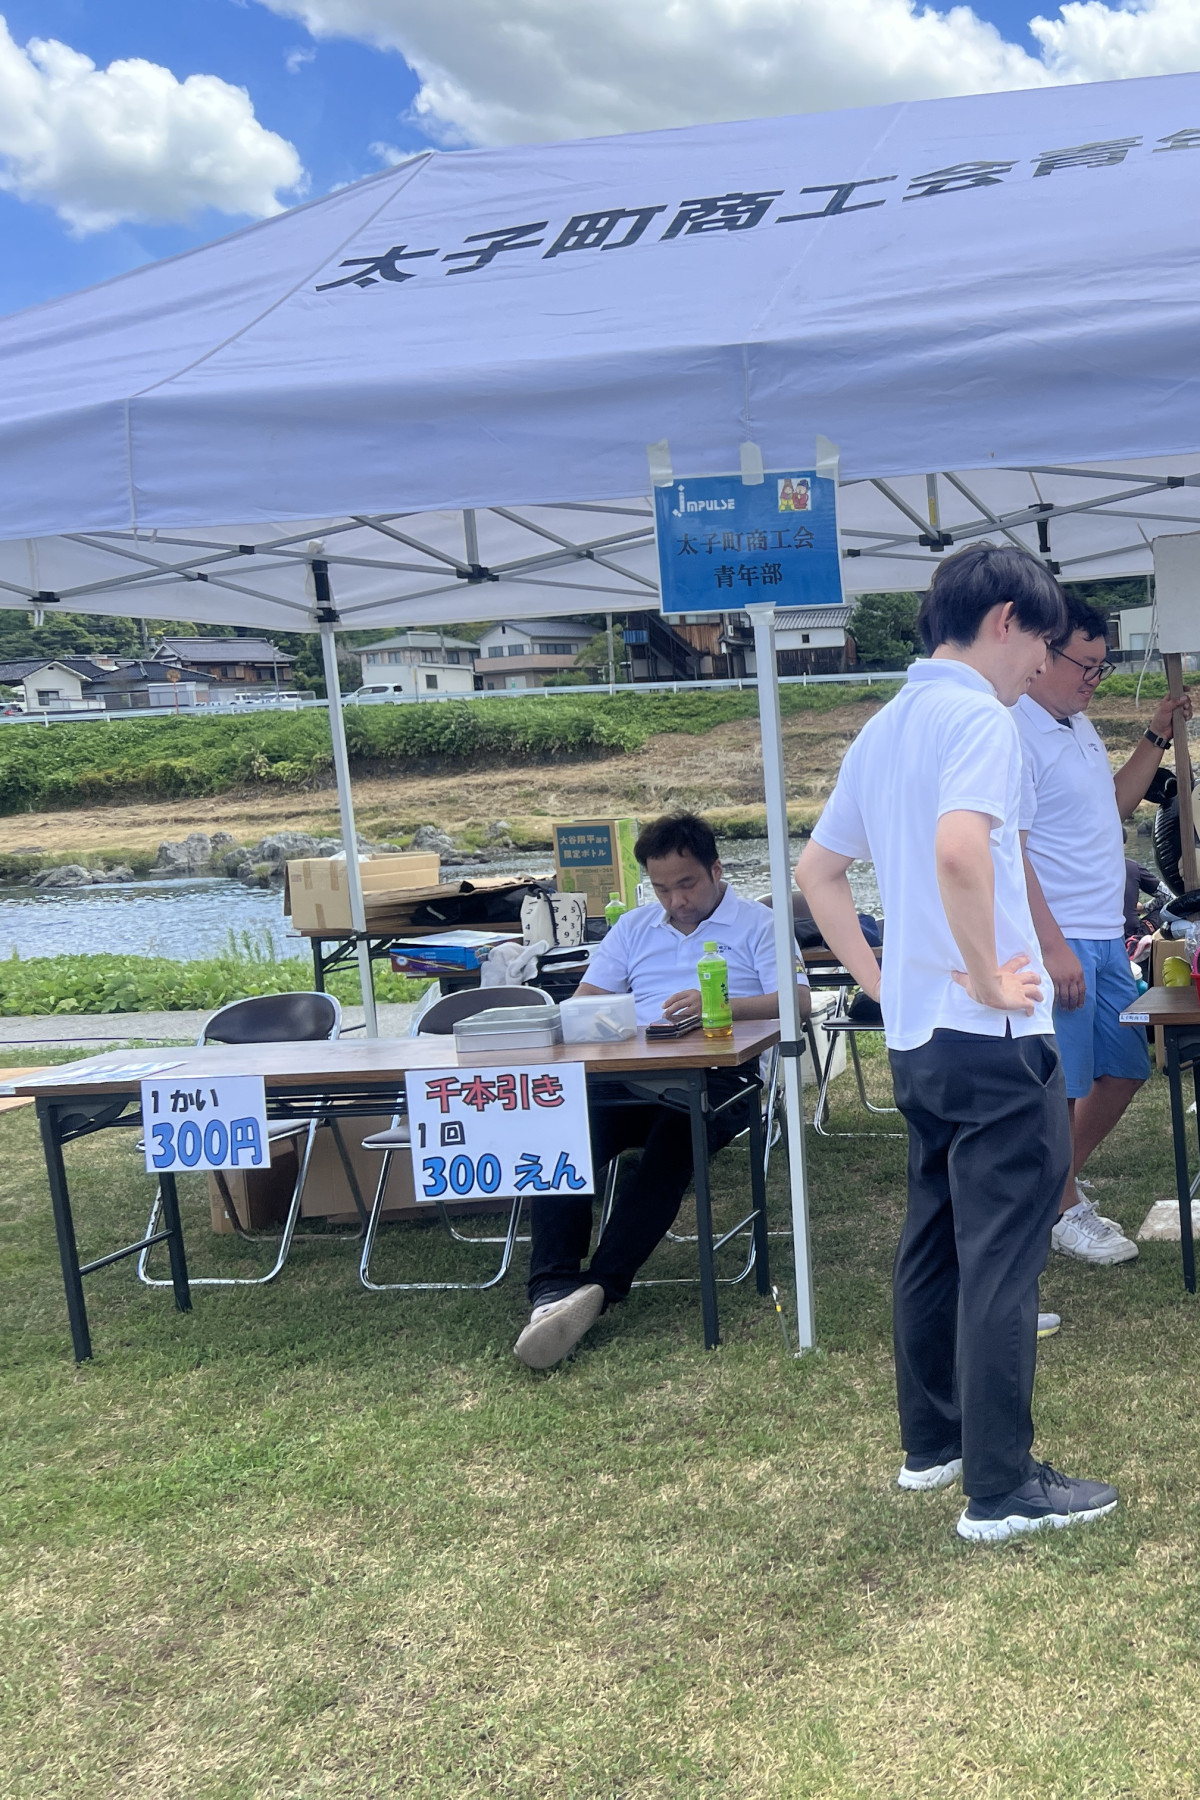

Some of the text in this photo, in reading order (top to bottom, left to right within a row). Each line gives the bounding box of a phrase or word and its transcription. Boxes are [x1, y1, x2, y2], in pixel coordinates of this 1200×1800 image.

[677, 526, 814, 556] 太子町商工会
[714, 563, 783, 588] 青年部
[426, 1074, 566, 1114] 千本引き
[152, 1116, 263, 1169] 300円
